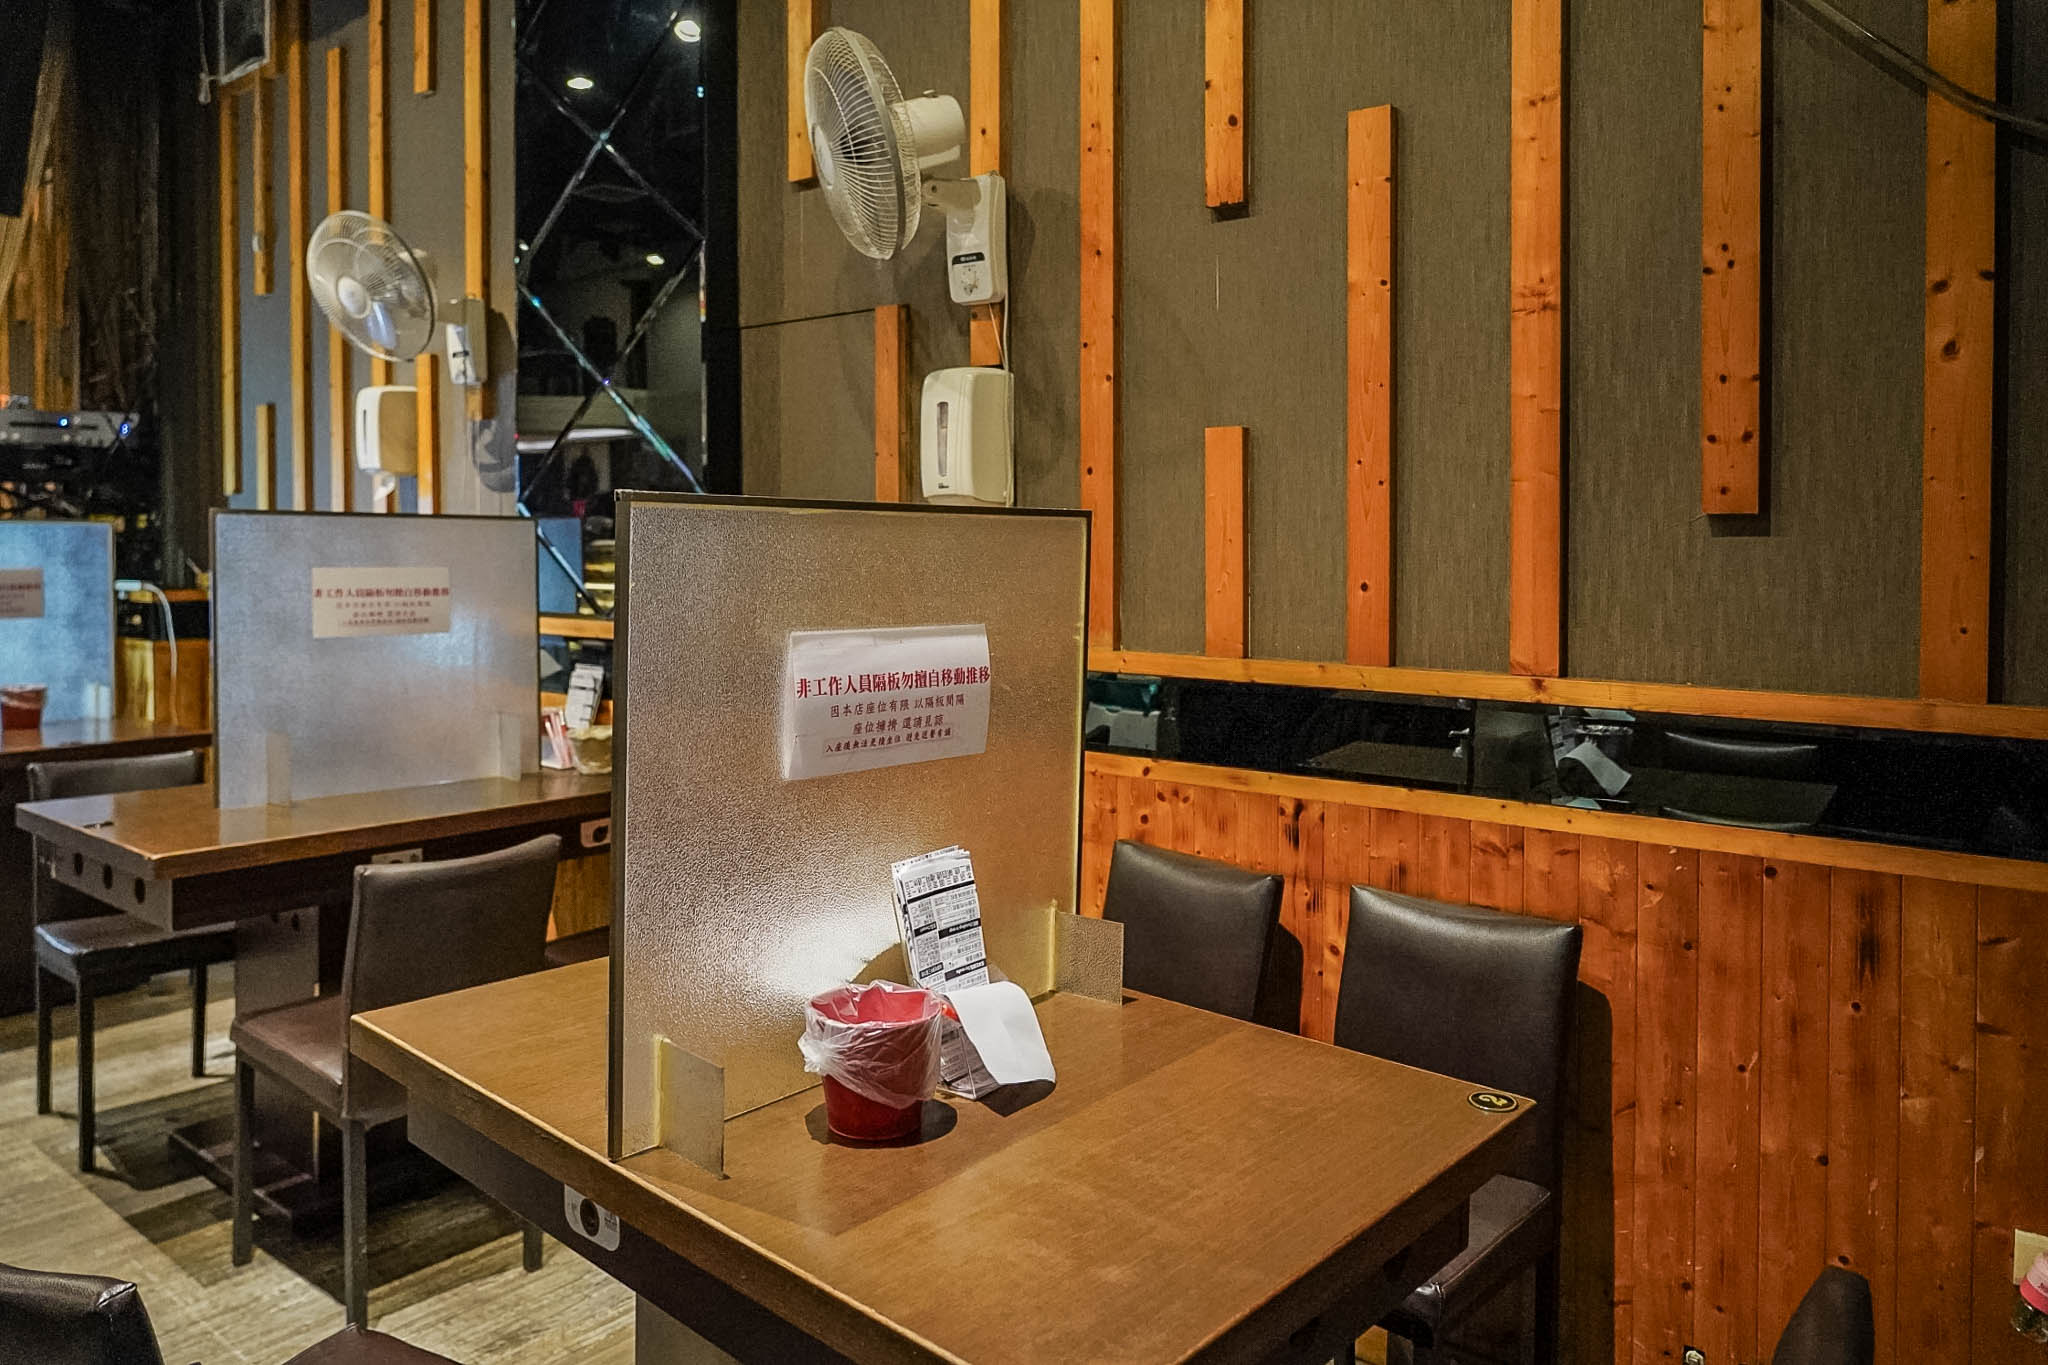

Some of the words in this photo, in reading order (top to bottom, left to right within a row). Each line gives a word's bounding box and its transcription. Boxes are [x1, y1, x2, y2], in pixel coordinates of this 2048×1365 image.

[796, 665, 990, 699] 非工作人員隔板勿擅自移動推移
